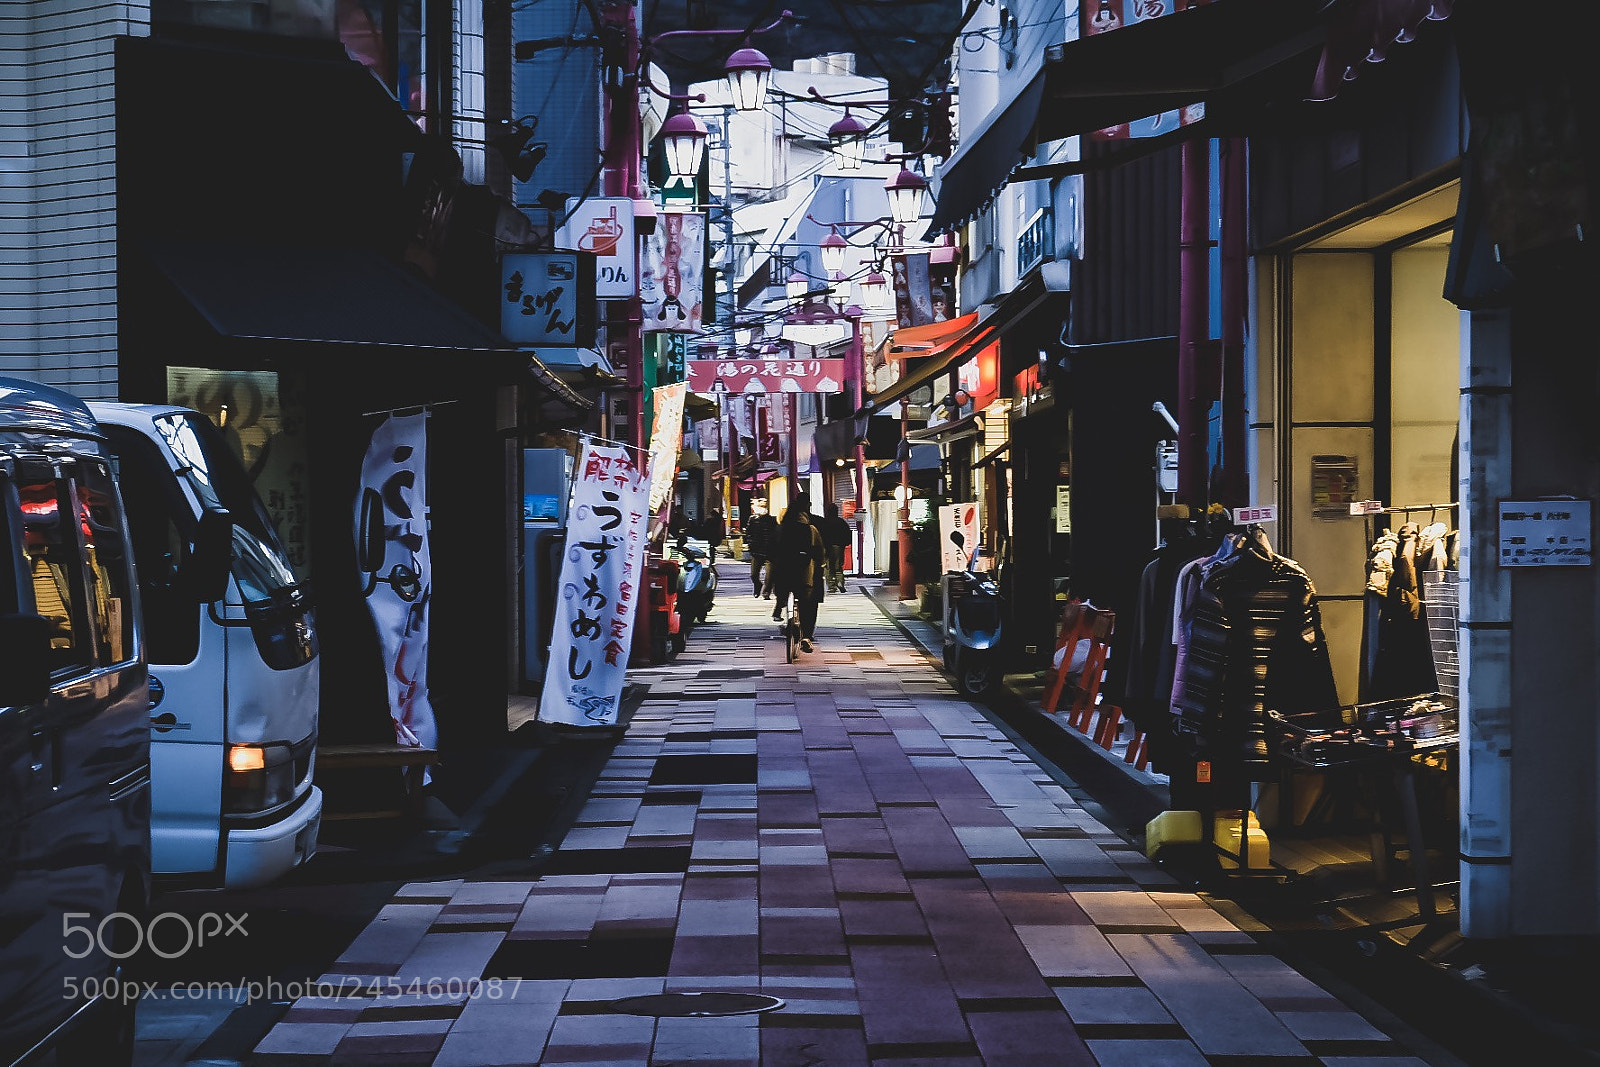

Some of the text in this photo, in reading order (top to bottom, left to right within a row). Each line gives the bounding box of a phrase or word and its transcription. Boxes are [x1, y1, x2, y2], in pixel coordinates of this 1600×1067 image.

[597, 267, 628, 283] りん
[568, 490, 624, 680] うずわめし
